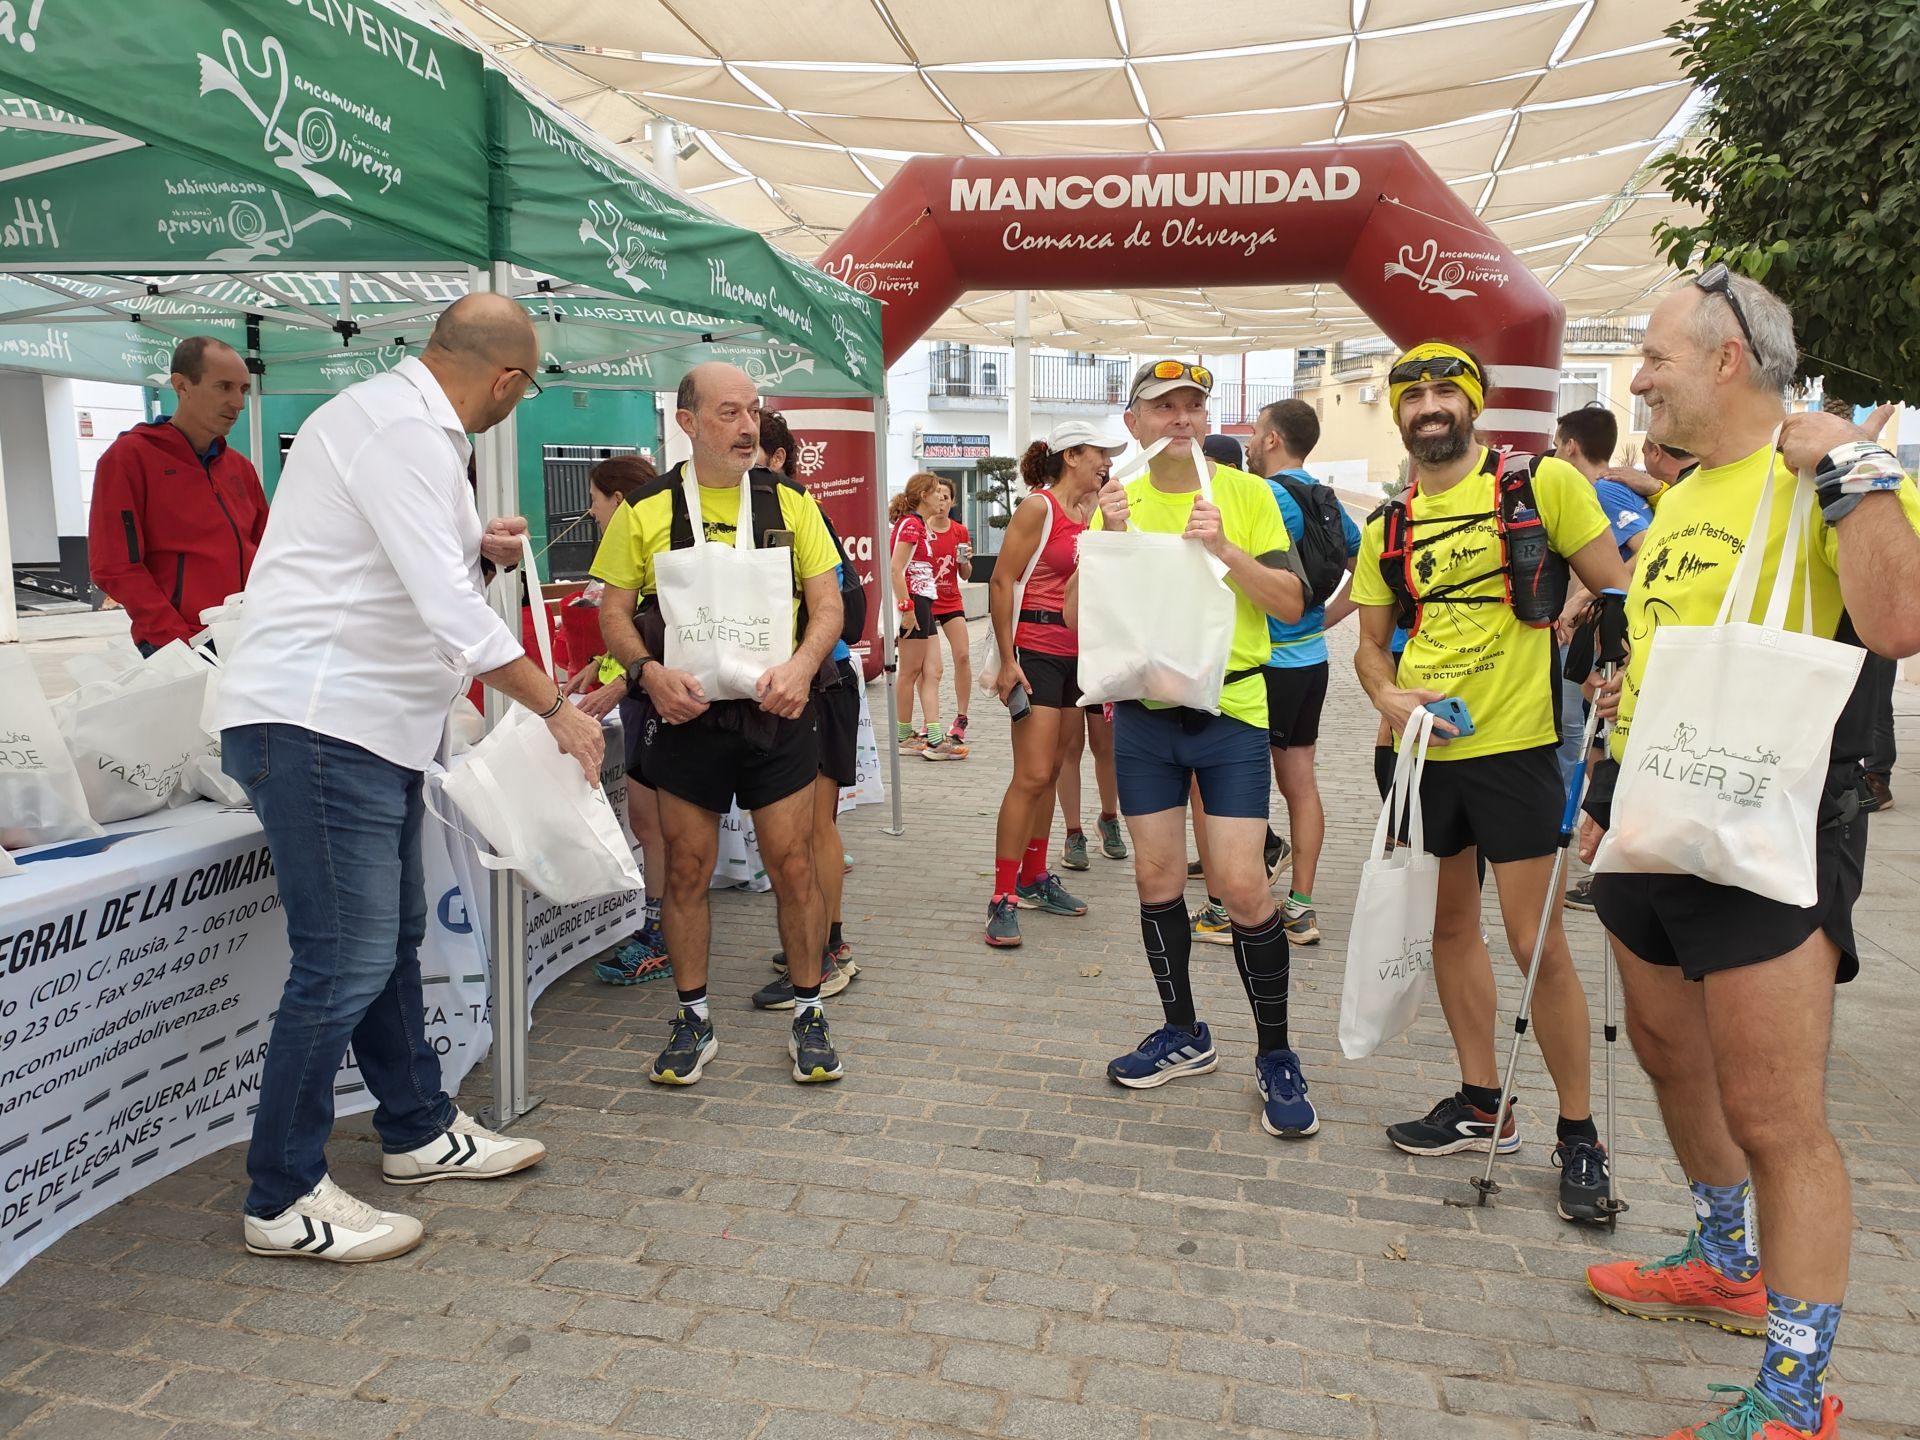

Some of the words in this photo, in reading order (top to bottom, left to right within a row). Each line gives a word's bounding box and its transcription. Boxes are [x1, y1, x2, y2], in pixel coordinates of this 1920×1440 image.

[288, 0, 447, 91] LIVENZA
[950, 165, 1361, 212] MANCOMUNIDAD
[1002, 221, 1113, 253] Comarca
[1124, 220, 1151, 248] de
[1161, 217, 1277, 257] Olivenza
[821, 478, 850, 489] Igualdad
[851, 476, 865, 484] Real
[1475, 662, 1495, 673] 2023
[96, 890, 141, 941] DE
[139, 877, 178, 924] LA
[540, 913, 582, 949] VALVERDE
[584, 906, 596, 925] DE
[29, 968, 82, 1009] (CID)
[116, 935, 169, 970] Rusia,
[174, 925, 188, 946] 2
[202, 901, 259, 934] 06100
[20, 1016, 49, 1043] 23
[54, 1002, 81, 1028] 05
[96, 983, 129, 1010] Fax
[131, 965, 166, 992] 924
[170, 953, 196, 974] 49
[198, 943, 219, 965] 01
[227, 933, 248, 954] 17
[4, 1132, 89, 1194] CHELES
[107, 1076, 196, 1135] HIGUERA
[203, 1060, 230, 1088] DE
[37, 1173, 68, 1206] DE
[70, 1116, 163, 1185] LEGANÉS
